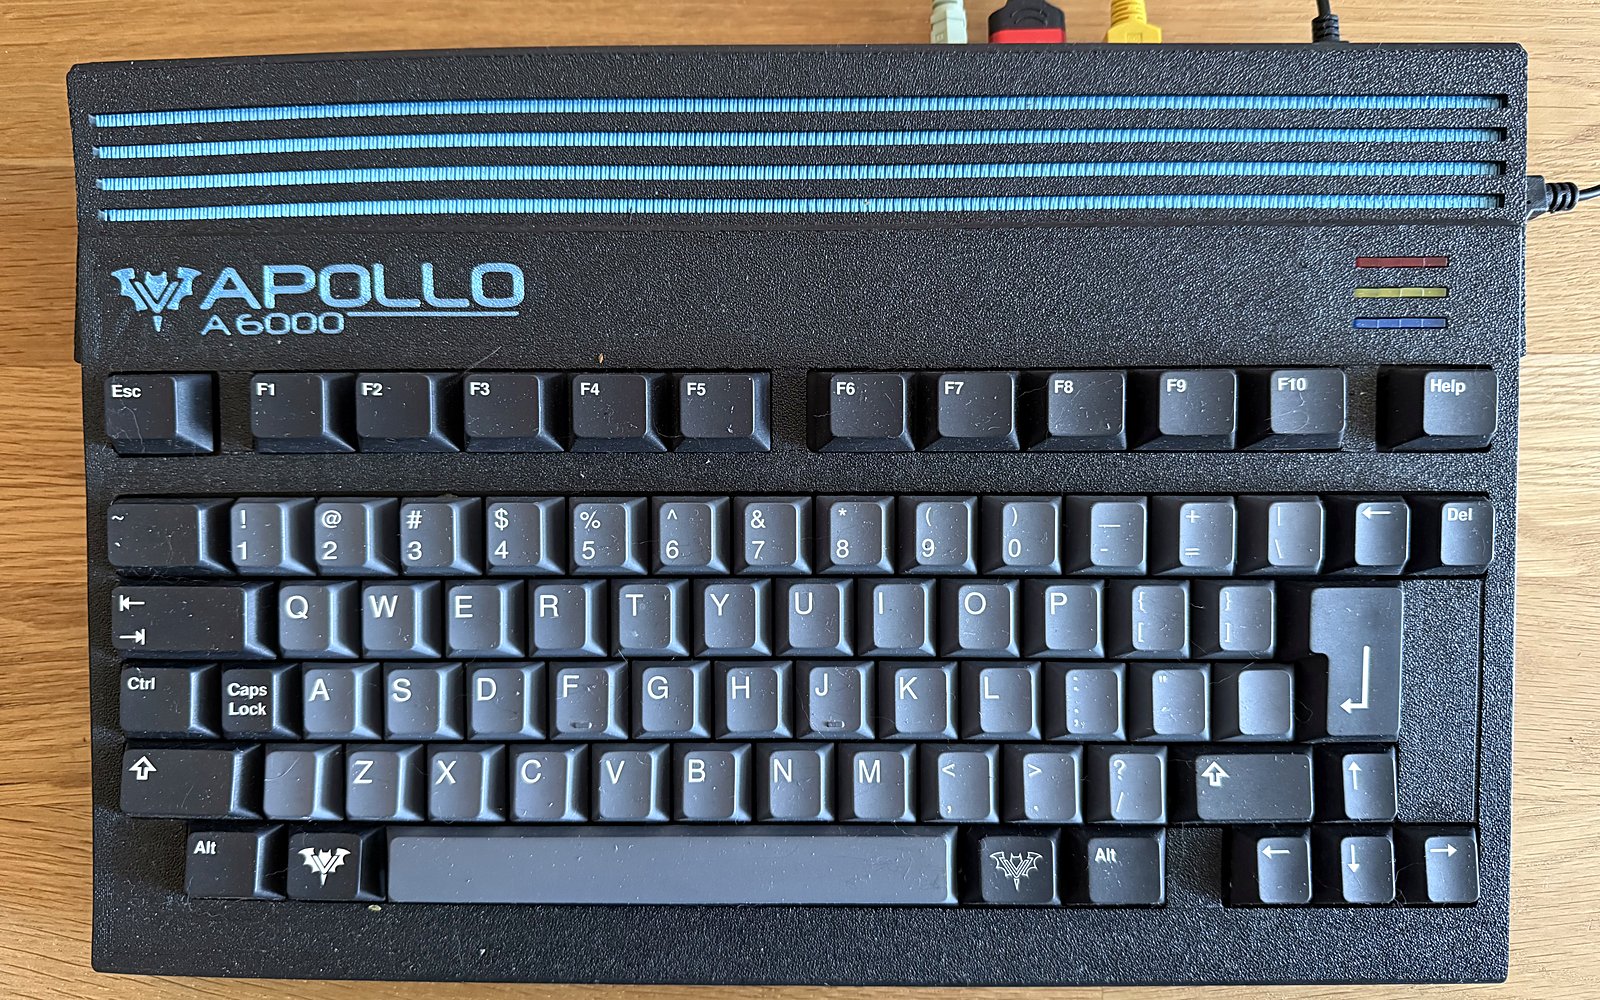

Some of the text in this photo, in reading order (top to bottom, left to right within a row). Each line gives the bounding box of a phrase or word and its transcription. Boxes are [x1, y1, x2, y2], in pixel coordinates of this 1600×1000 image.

[200, 263, 525, 309] APOLLO
[112, 385, 141, 397] Esc
[257, 383, 274, 395] F1
[362, 383, 382, 395] F2
[470, 382, 490, 395] F3
[581, 383, 600, 395] F4
[687, 383, 706, 396] F5
[837, 382, 855, 395] F6
[945, 381, 964, 394] F7
[1055, 380, 1073, 393] F8
[1167, 379, 1186, 392] F9
[1278, 378, 1306, 391] F10
[1431, 379, 1465, 395] Help
[241, 510, 246, 528] !
[321, 510, 341, 528] @
[406, 511, 422, 529] #
[495, 508, 508, 530] $
[580, 510, 600, 529] %
[751, 510, 765, 528] &
[926, 507, 931, 526] (
[1012, 507, 1017, 526] )
[1186, 510, 1200, 523] +
[1447, 507, 1472, 521] Del
[237, 542, 246, 559] 1
[322, 541, 337, 559] 2
[408, 541, 422, 560] 3
[495, 541, 508, 559] 4
[582, 541, 595, 559] 5
[666, 540, 678, 558] 6
[752, 541, 764, 559] 7
[836, 540, 849, 558] 8
[922, 539, 934, 557] 9
[1009, 539, 1021, 557] 0
[1184, 547, 1200, 556] =
[285, 596, 308, 619] Q
[369, 595, 398, 618] W
[455, 596, 473, 618] E
[540, 595, 558, 617] R
[626, 594, 643, 616] T
[710, 594, 729, 616] Y
[795, 592, 812, 614] U
[879, 592, 883, 614] I
[964, 592, 986, 615] O
[1051, 593, 1067, 615] P
[1138, 592, 1146, 611] {
[1225, 591, 1231, 611] }
[1138, 622, 1144, 642] [
[1225, 623, 1231, 642] ]
[128, 677, 155, 690] Ctrl
[227, 683, 267, 699] Caps
[308, 679, 329, 701] A
[392, 679, 411, 702] S
[477, 678, 496, 701] D
[563, 675, 579, 697] F
[648, 676, 668, 699] G
[732, 676, 749, 699] H
[815, 674, 827, 696] J
[900, 677, 917, 699] K
[984, 677, 999, 699] L
[229, 702, 266, 715] Lock
[353, 761, 373, 784] Z
[435, 761, 456, 784] X
[521, 760, 541, 783] C
[606, 760, 624, 784] V
[689, 759, 705, 782] B
[774, 759, 791, 783] N
[859, 760, 880, 783] M
[942, 764, 955, 777] <
[1028, 764, 1041, 778] >
[1113, 760, 1126, 780] ?
[194, 841, 216, 854] Alt
[1095, 848, 1117, 863] Alt
